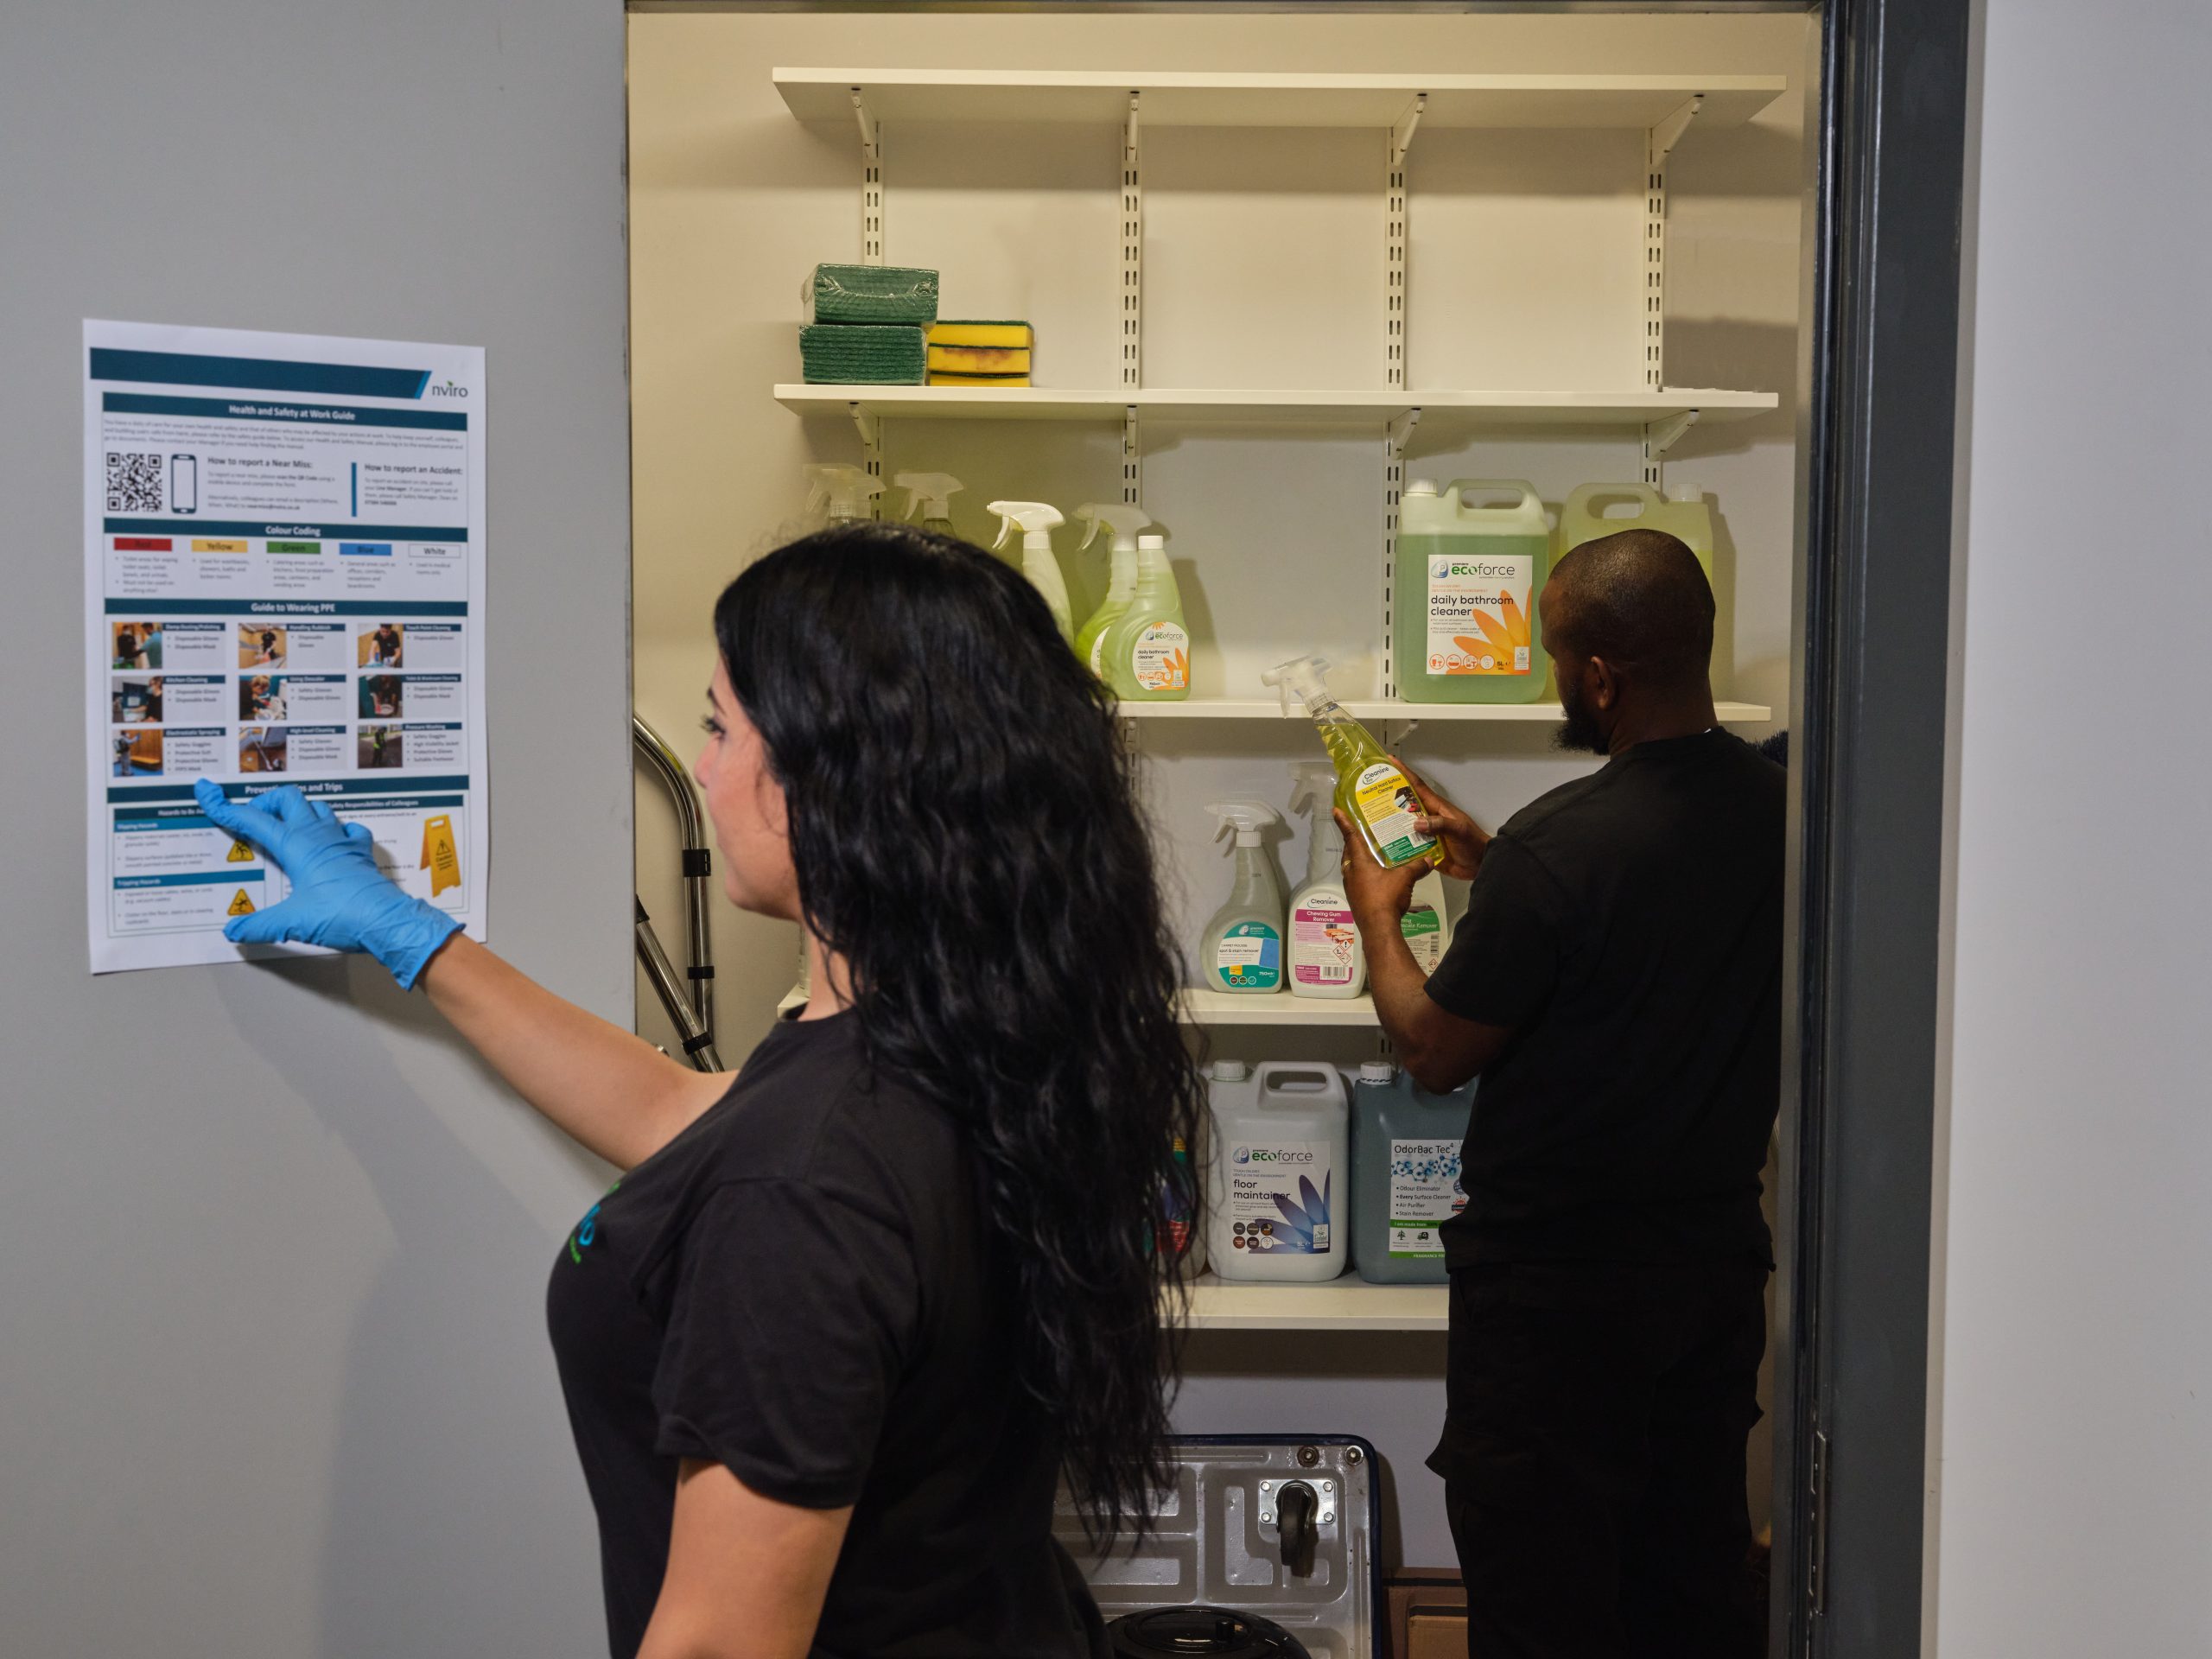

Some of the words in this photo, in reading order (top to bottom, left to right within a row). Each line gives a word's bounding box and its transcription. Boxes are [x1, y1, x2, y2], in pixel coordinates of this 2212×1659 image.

[432, 380, 468, 397] nviro
[229, 404, 256, 416] Health
[257, 406, 272, 416] and
[273, 407, 297, 418] Safety
[300, 409, 308, 417] at
[308, 409, 332, 418] Work
[334, 410, 355, 421] Guide
[238, 459, 264, 467] report
[429, 467, 463, 475] Accident:
[265, 526, 292, 535] Colour
[293, 527, 321, 537] Coding
[207, 542, 233, 550] Yellow
[1452, 563, 1515, 575] ecoforce
[1431, 595, 1457, 606] daily
[1460, 595, 1514, 604] bathroom
[251, 603, 275, 612] Guide
[287, 603, 320, 613] Wearing
[1431, 607, 1471, 615] cleaner
[1364, 767, 1389, 779] Cleanline
[325, 783, 343, 792] Trips
[1362, 786, 1377, 795] Neutral
[1395, 1145, 1433, 1154] OdorBac
[1252, 1150, 1313, 1161] ecoforce
[1234, 1179, 1257, 1188] floor
[1234, 1191, 1290, 1199] maintainer
